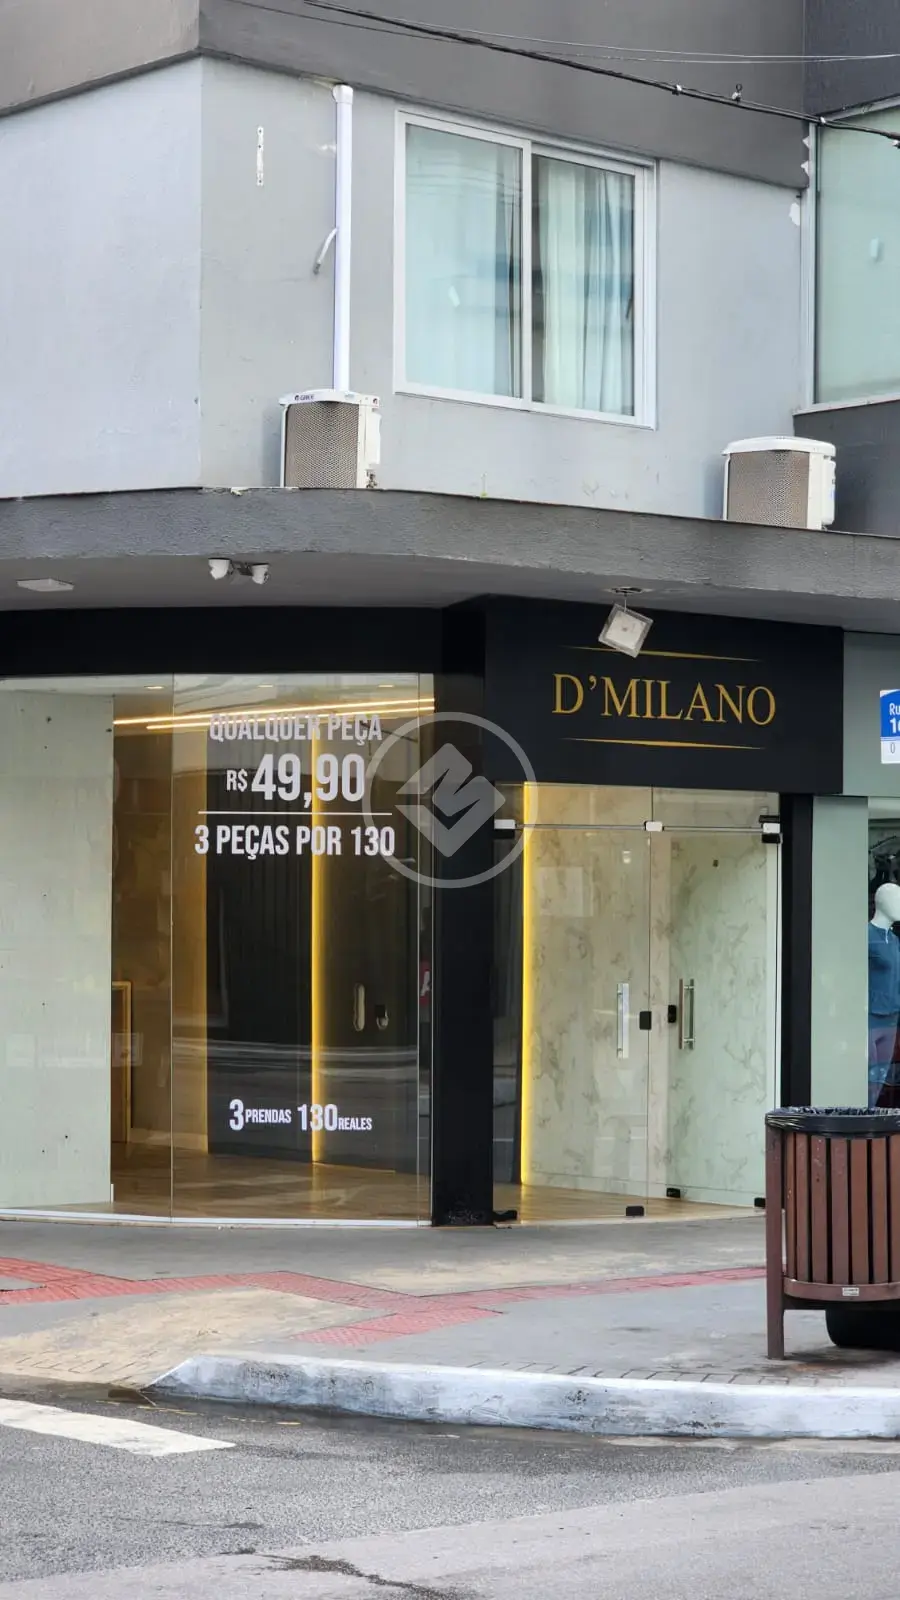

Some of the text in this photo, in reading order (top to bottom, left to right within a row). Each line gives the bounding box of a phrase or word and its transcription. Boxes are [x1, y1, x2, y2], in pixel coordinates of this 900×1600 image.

[209, 714, 383, 746] QUALQUER PEÇA
[226, 752, 365, 808] R$ 49,90
[194, 824, 396, 860] 3 PEÇAS POR 130
[229, 1098, 373, 1131] 3 PRENDAS 130 REALES
